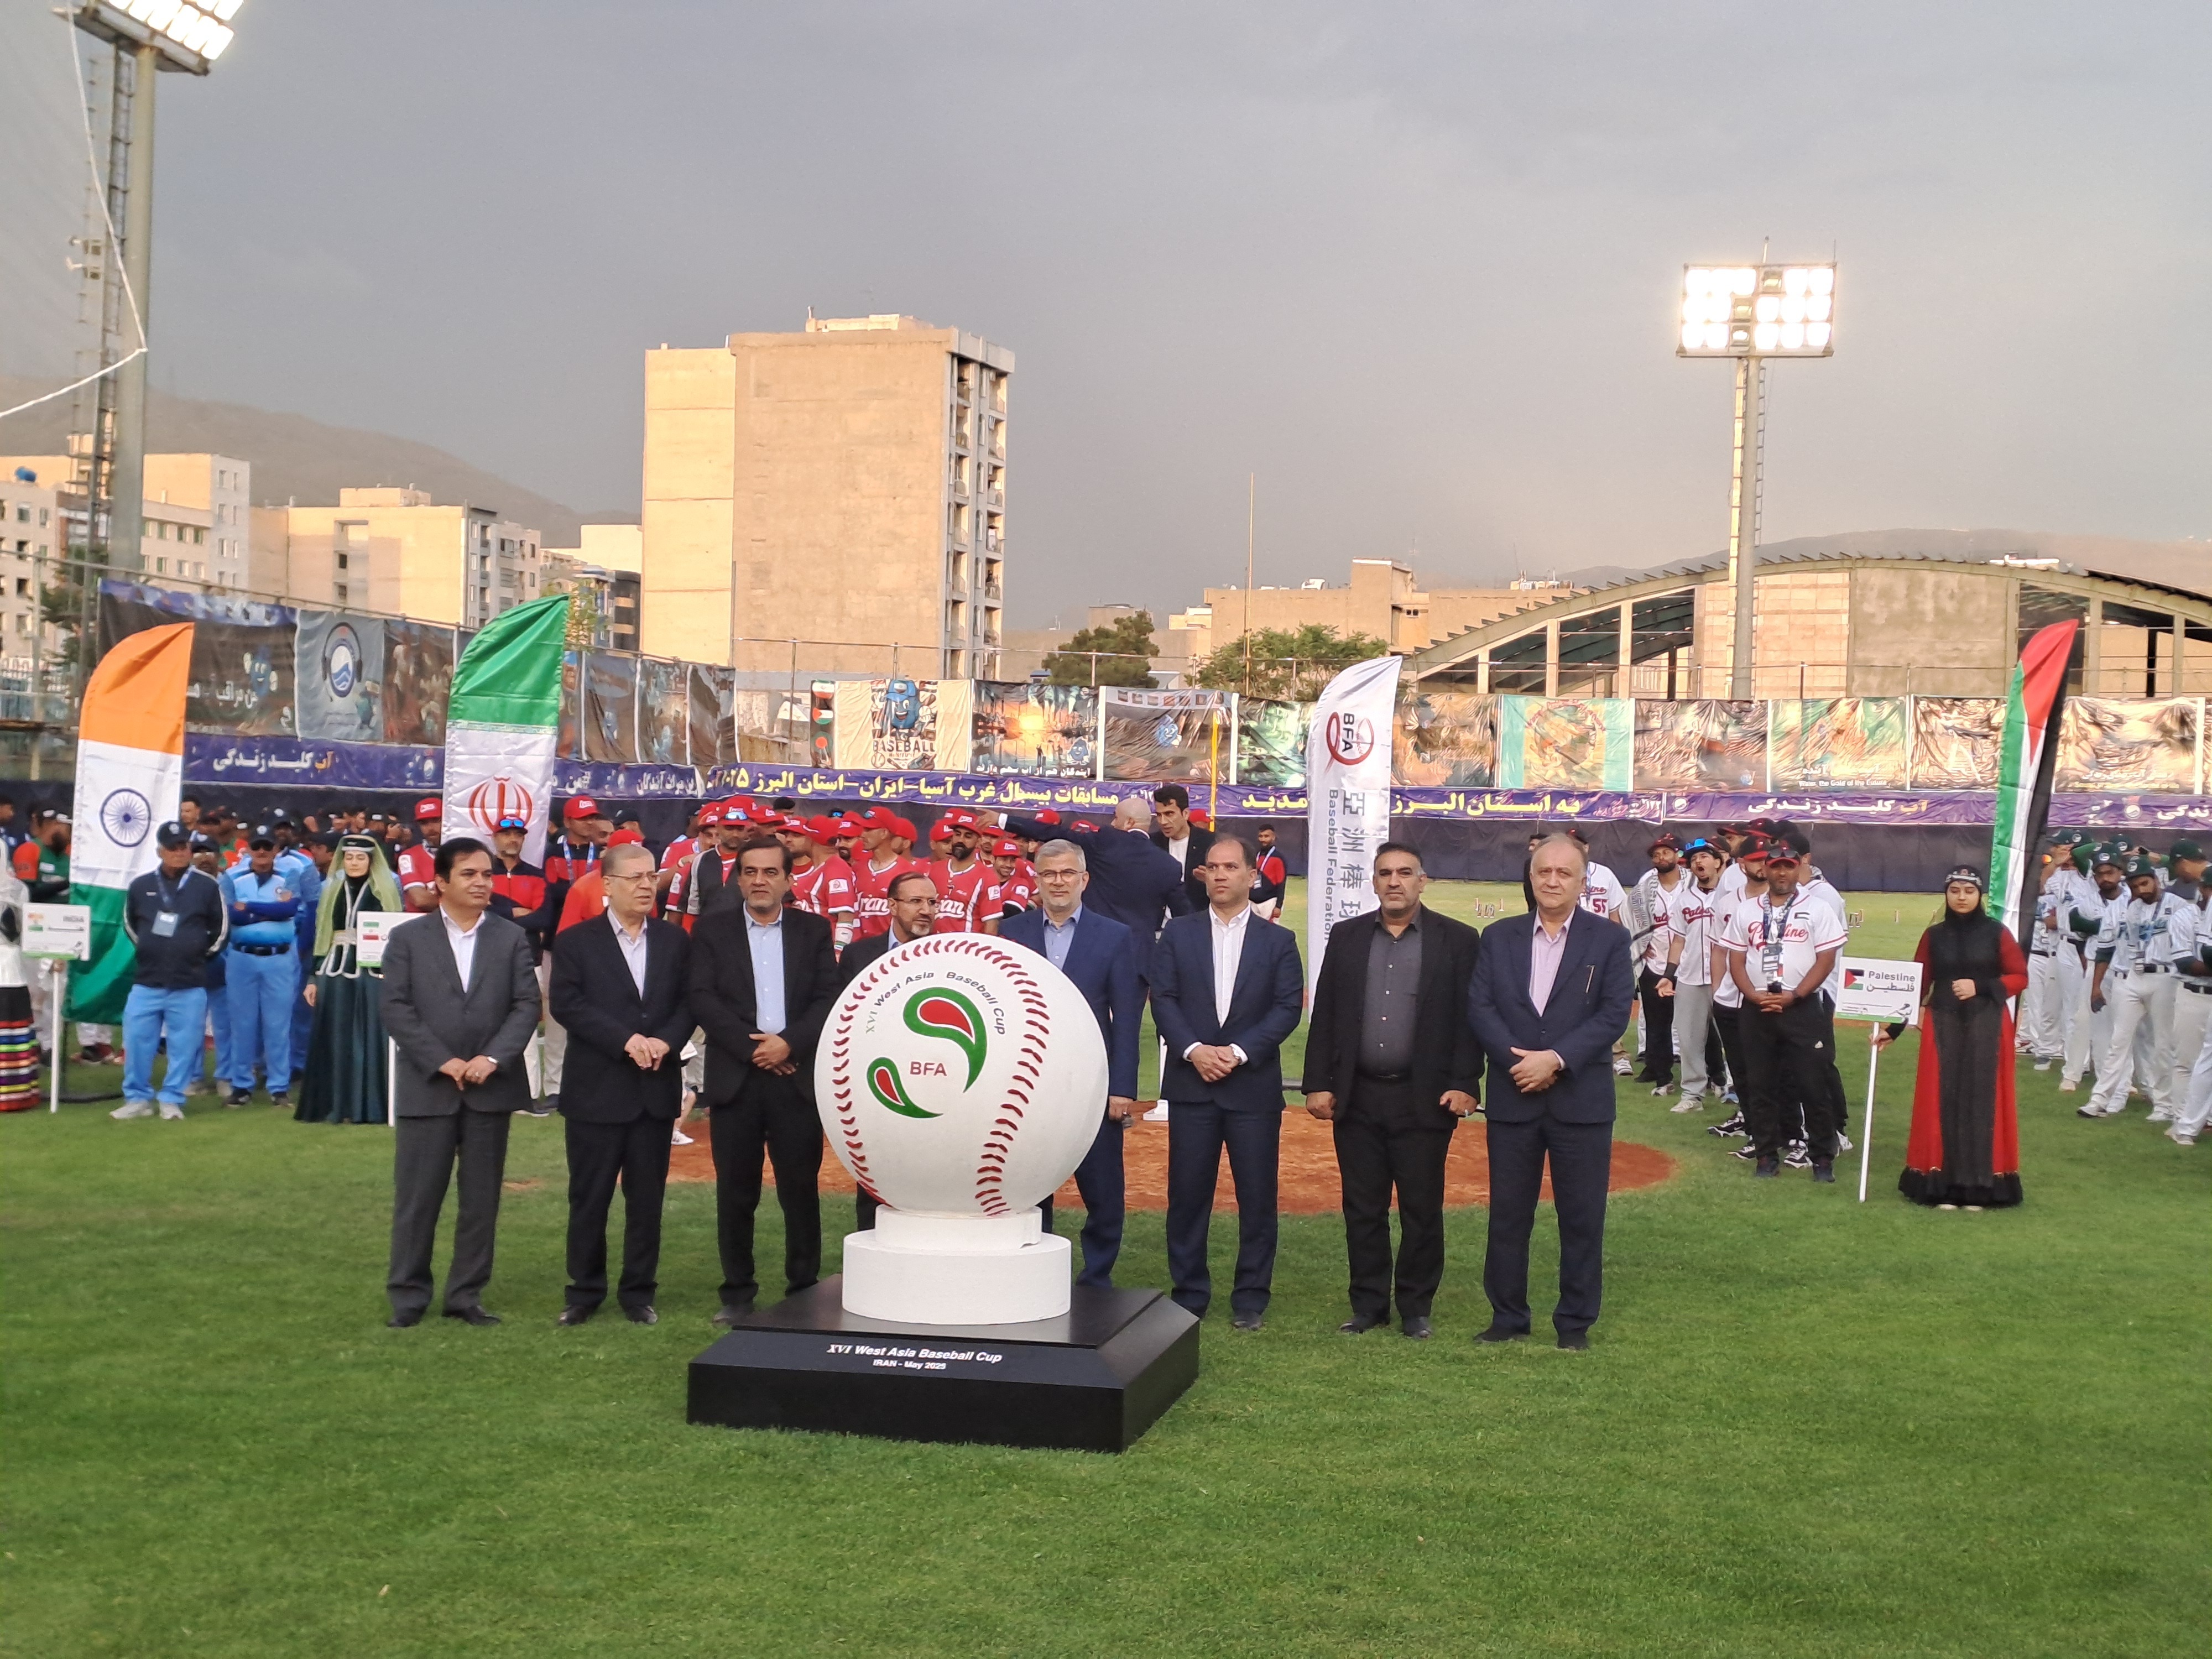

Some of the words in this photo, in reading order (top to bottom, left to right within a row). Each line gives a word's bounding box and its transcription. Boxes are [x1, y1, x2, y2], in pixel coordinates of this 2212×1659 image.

[1342, 712, 1355, 753] BFA
[873, 740, 936, 753] BASEBALL
[212, 747, 268, 774] زندگی
[268, 750, 315, 773] کلید
[314, 750, 335, 772] آب
[753, 770, 794, 794] البرز
[958, 781, 996, 802] غرب
[1000, 781, 1051, 805] بیسبال
[1054, 786, 1119, 808] مسابقات
[1390, 792, 1465, 815] البرز
[1467, 793, 1551, 816] استان
[1556, 797, 1580, 817] به
[1747, 797, 1822, 815] زندگی
[1827, 800, 1896, 815] کلید
[1899, 799, 1929, 816] آب
[1328, 789, 1339, 854] Baseball
[1868, 971, 1916, 982] Palestine
[1866, 982, 1915, 993] فلسطین
[865, 1010, 878, 1034] XVI
[874, 982, 901, 1007] West
[905, 972, 935, 985] Asia
[946, 971, 999, 1005] Baseball
[993, 1008, 1006, 1035] Cup
[910, 1061, 947, 1077] BFA
[826, 1344, 853, 1354] XVI
[854, 1345, 887, 1355] West
[886, 1347, 916, 1357] Asia
[918, 1349, 975, 1361] Baseball
[975, 1352, 1003, 1364] Cup
[873, 1359, 898, 1367] IRAN
[904, 1360, 924, 1370] May
